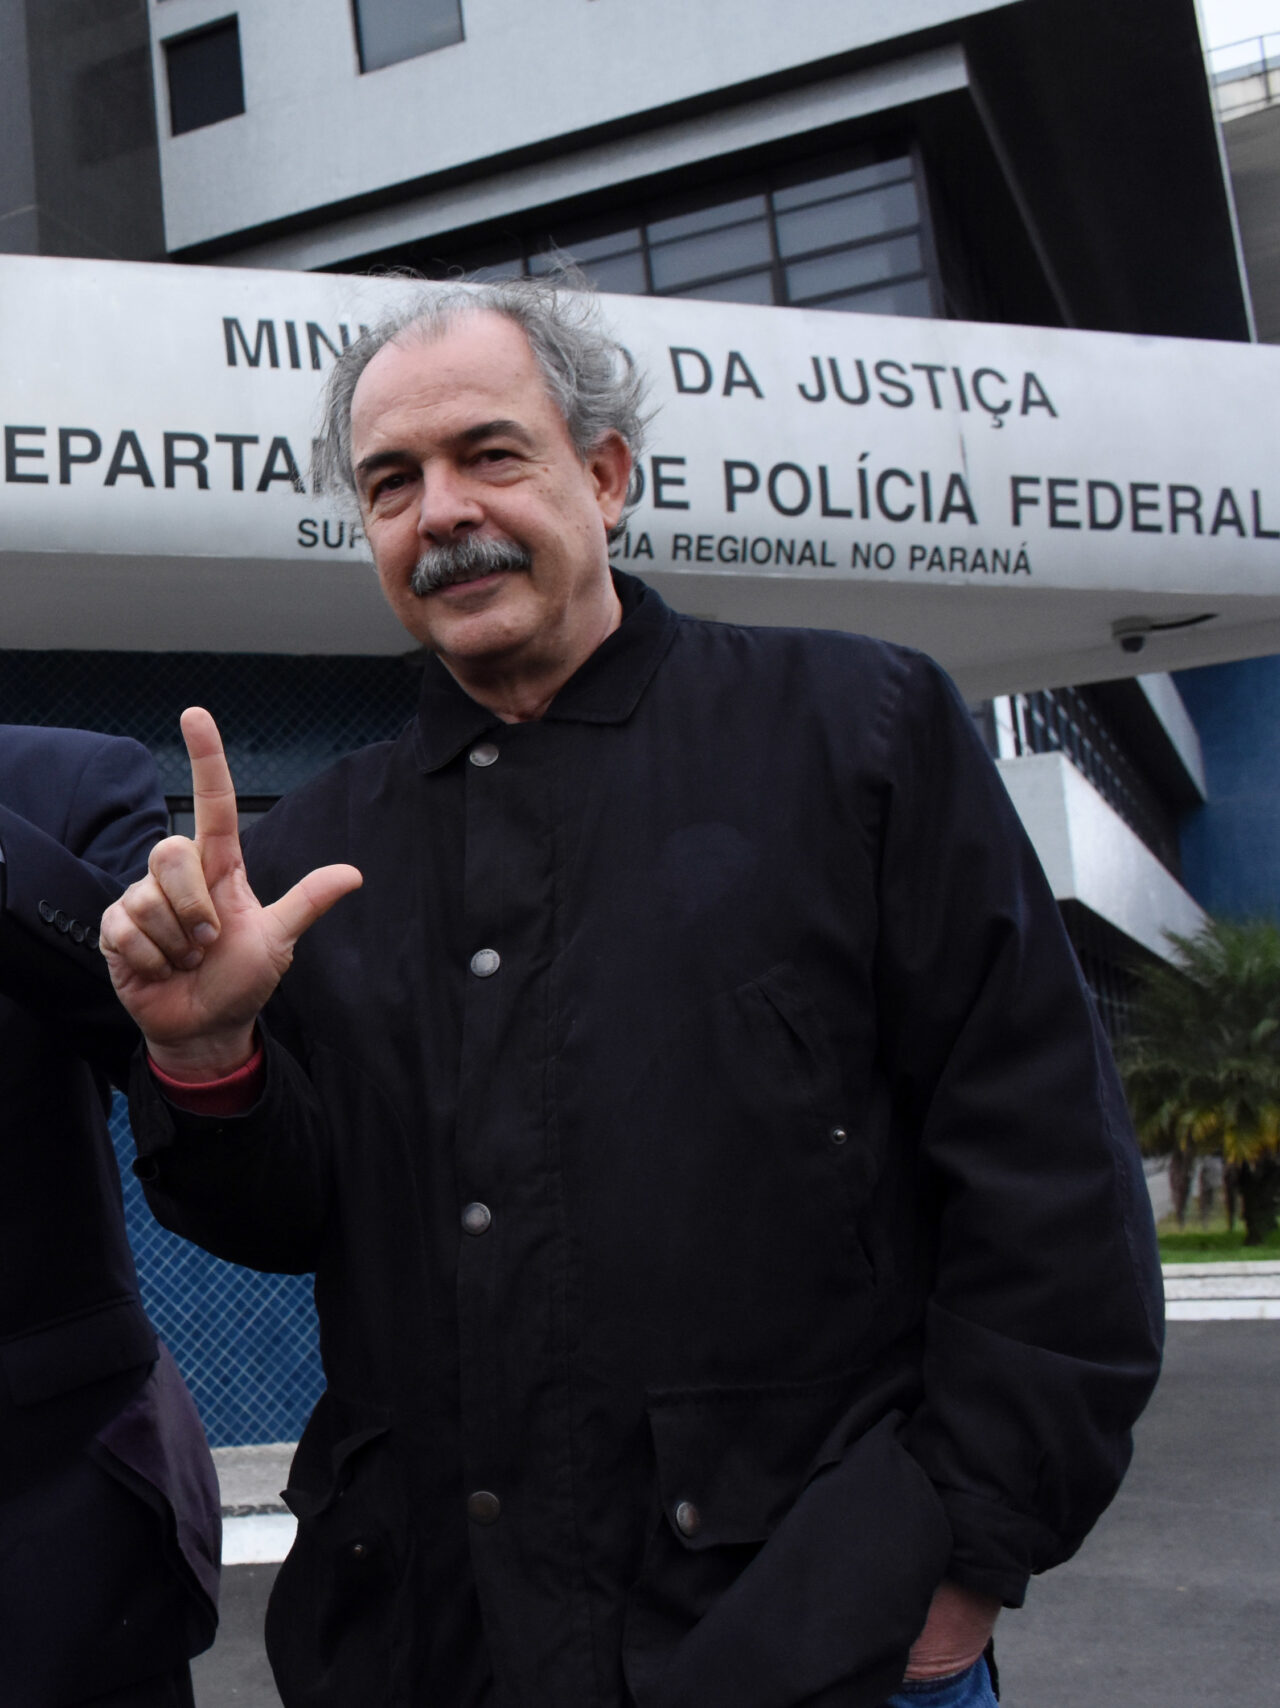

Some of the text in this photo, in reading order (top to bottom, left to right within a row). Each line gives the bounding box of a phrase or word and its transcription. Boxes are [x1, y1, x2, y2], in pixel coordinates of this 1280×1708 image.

[222, 316, 368, 370] MIN
[668, 346, 765, 399] DA
[797, 355, 1059, 429] JUSTIÇA
[723, 452, 979, 526] POLÍCIA
[1010, 475, 1280, 539] FEDERAL
[671, 533, 837, 569] REGIONAL
[850, 542, 896, 571] NO
[908, 541, 1032, 575] PARANÁ
